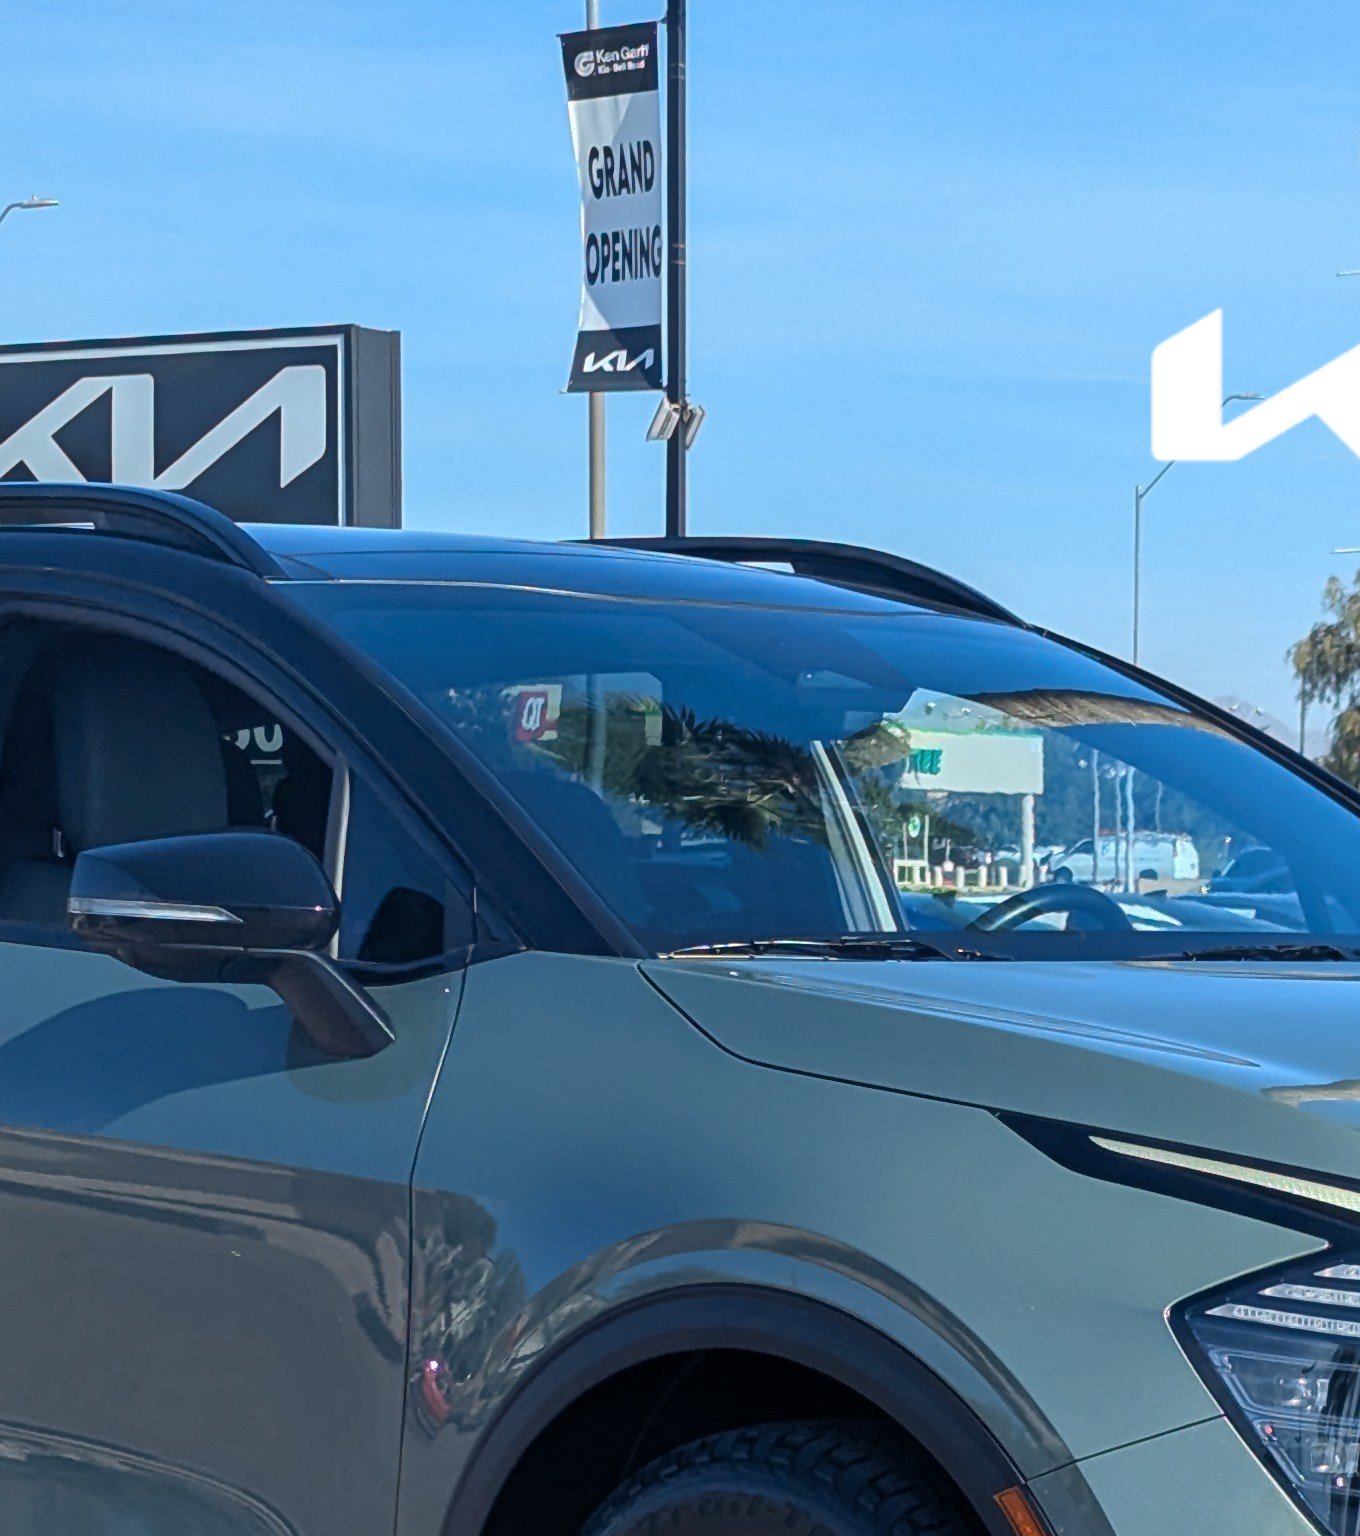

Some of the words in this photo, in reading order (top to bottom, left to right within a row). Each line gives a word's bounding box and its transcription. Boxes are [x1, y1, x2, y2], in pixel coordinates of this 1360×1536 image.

[588, 139, 655, 200] GRAND
[585, 224, 663, 286] OPENING
[582, 348, 655, 373] KIA
